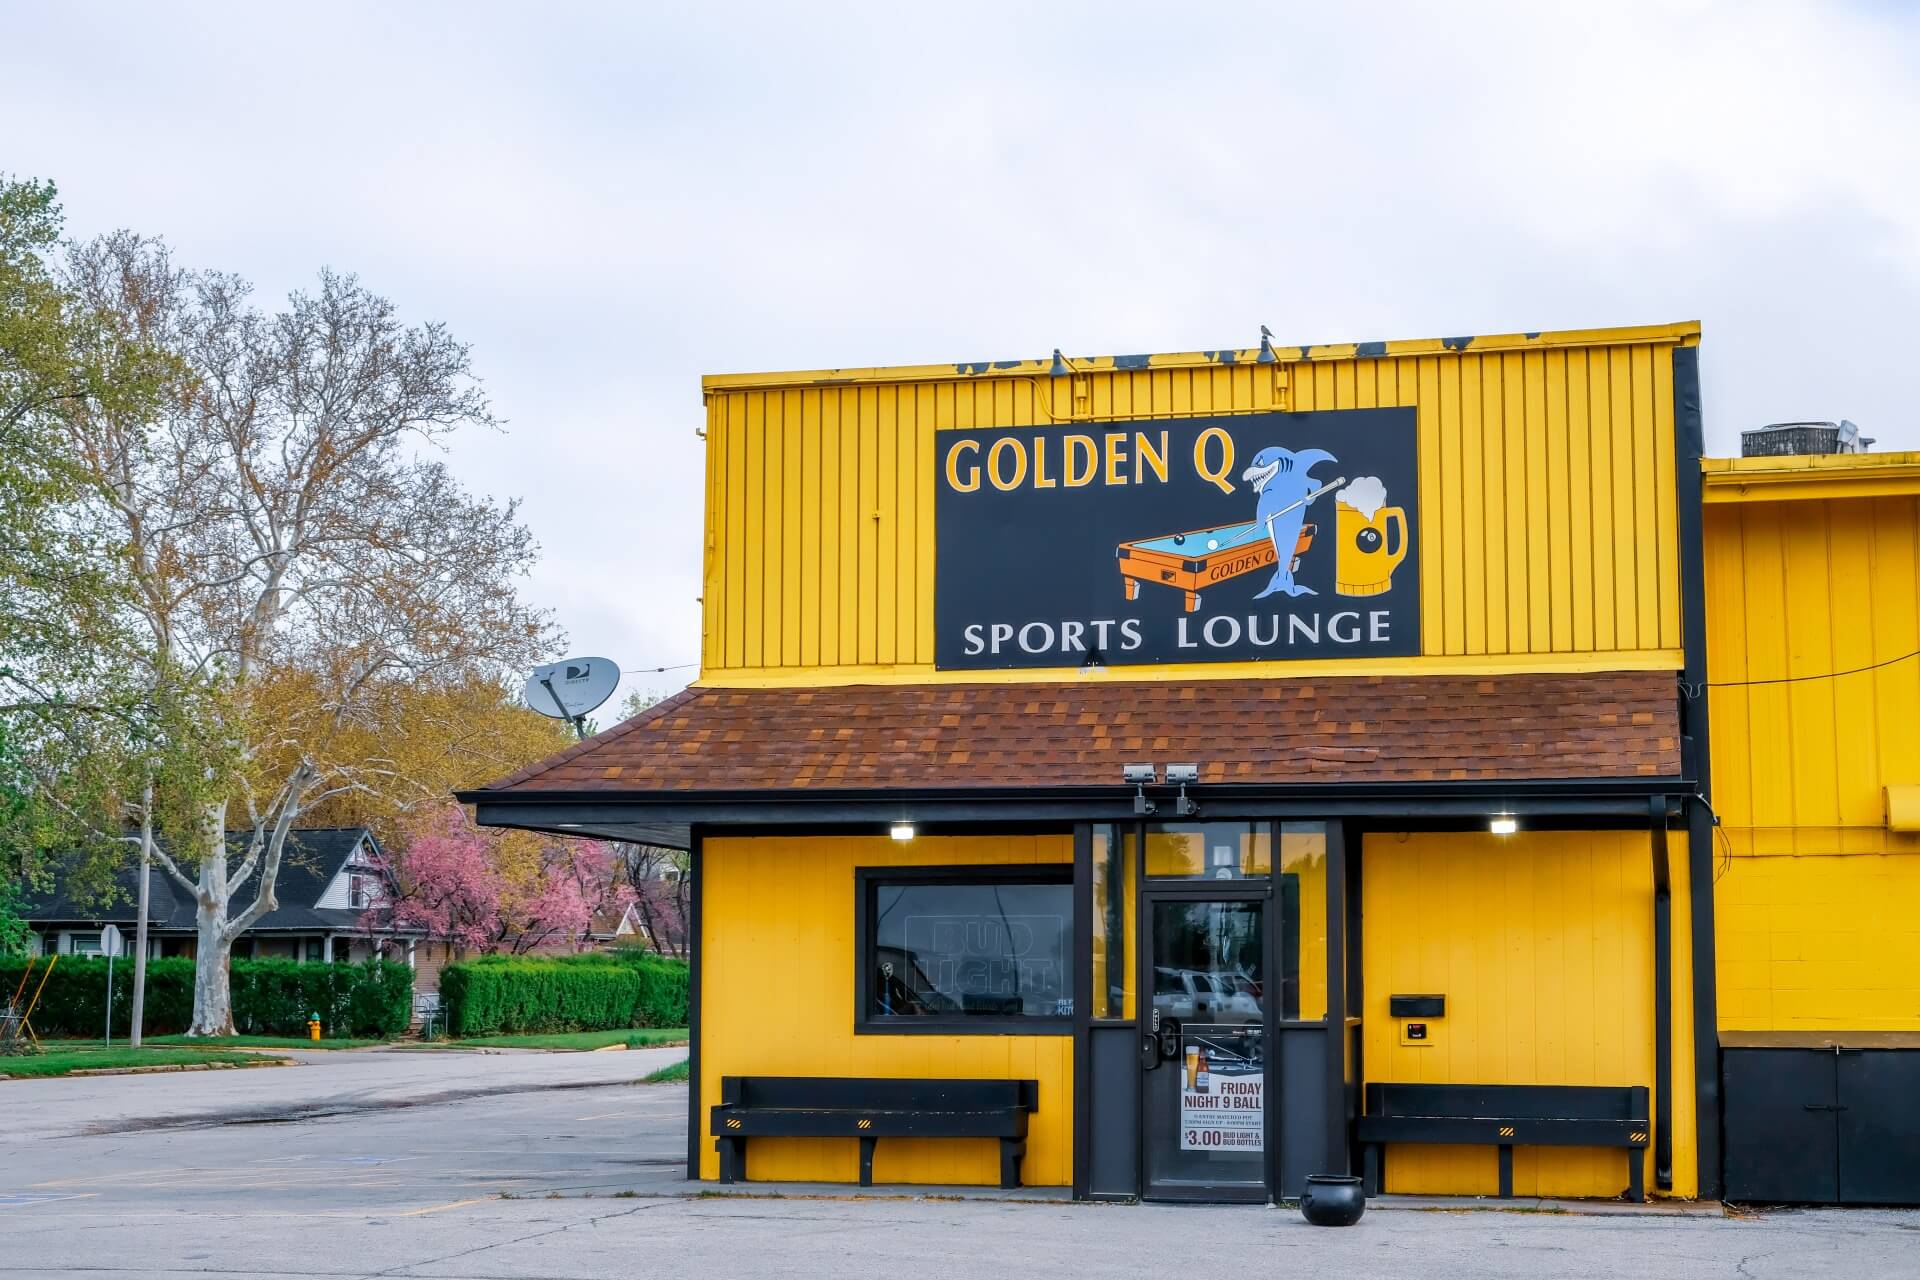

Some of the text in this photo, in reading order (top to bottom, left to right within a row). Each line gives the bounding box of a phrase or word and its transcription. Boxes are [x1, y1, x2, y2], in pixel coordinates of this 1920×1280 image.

[945, 427, 1236, 496] GOLDEN Q
[1210, 549, 1275, 581] GOLDEN Q
[963, 610, 1392, 656] SPORTS LOUNGE
[933, 921, 1034, 957] BUD
[914, 958, 1054, 994] LIGHT
[1185, 1095, 1261, 1109] NIGHT 9 BALL
[1220, 1082, 1262, 1095] FRIDAY
[1185, 1130, 1221, 1146] $3.00
[1223, 1131, 1235, 1139] BUD
[1237, 1131, 1253, 1139] LIGHT
[1236, 1139, 1262, 1147] BOTTLES
